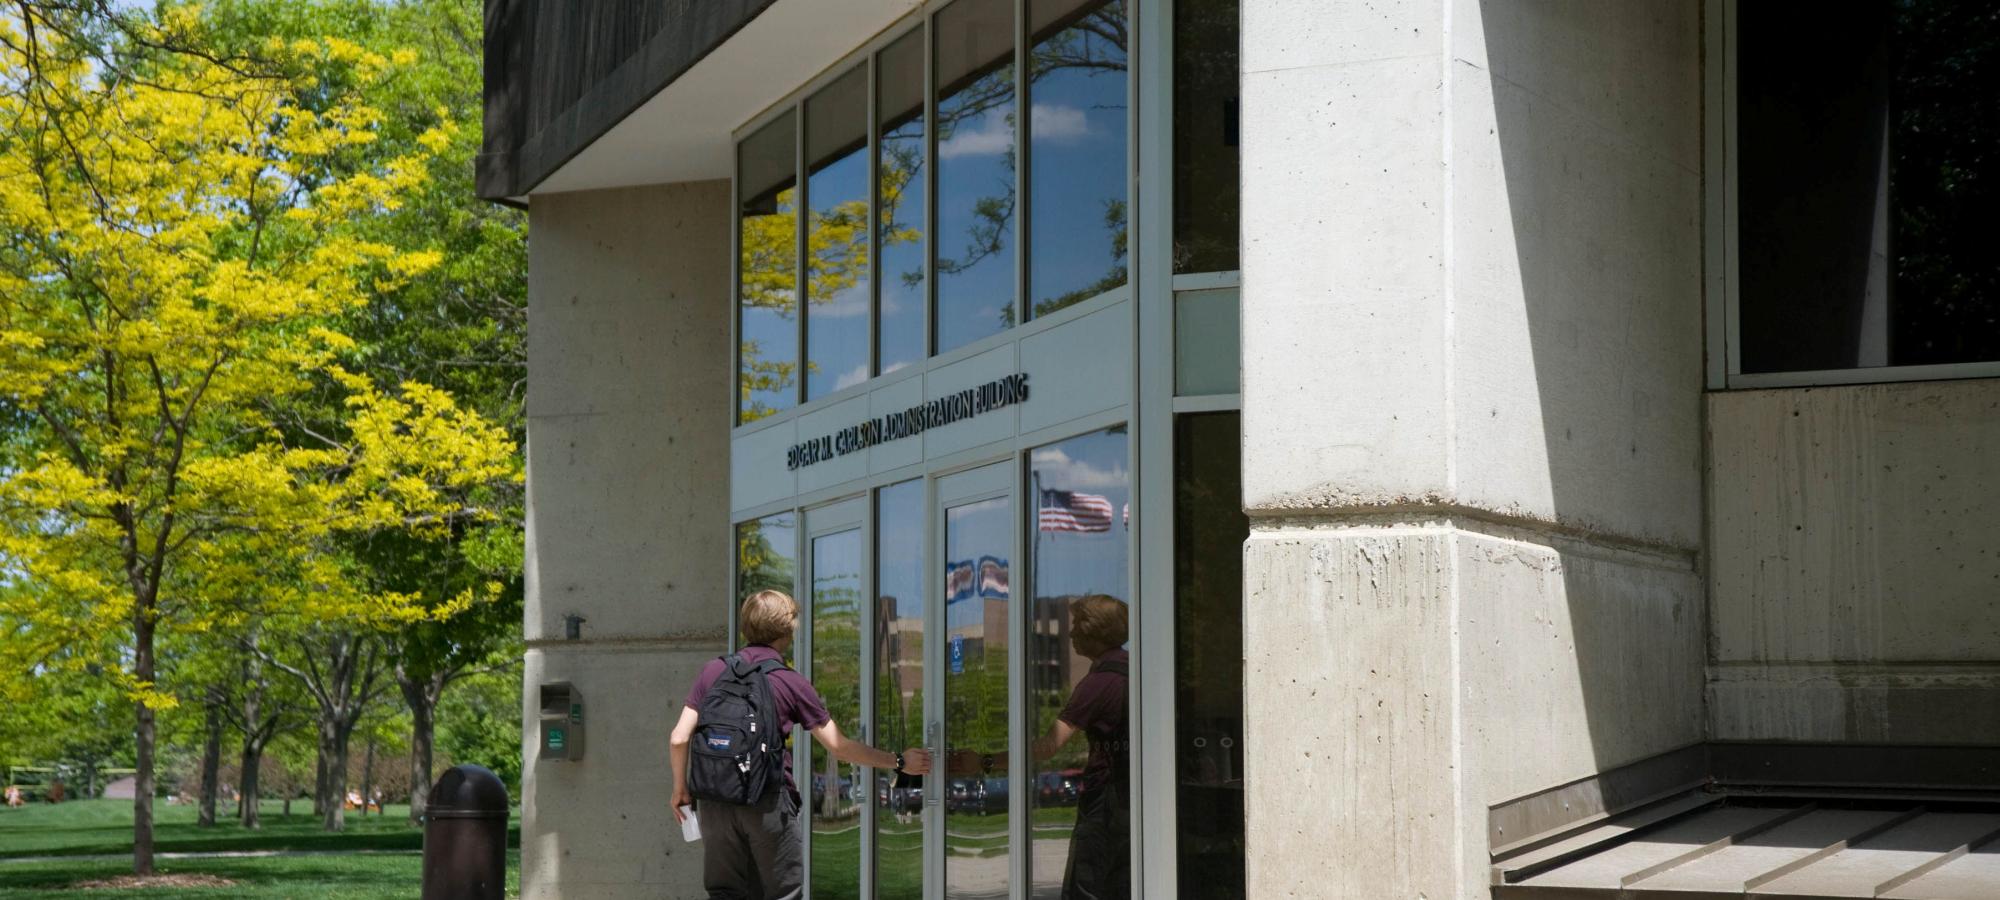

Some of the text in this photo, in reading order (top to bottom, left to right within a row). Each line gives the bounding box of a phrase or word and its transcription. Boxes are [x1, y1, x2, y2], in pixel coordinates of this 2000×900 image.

[788, 373, 1030, 471] EDGAR M. CARLSON ADMINISTRATION BUILDING
